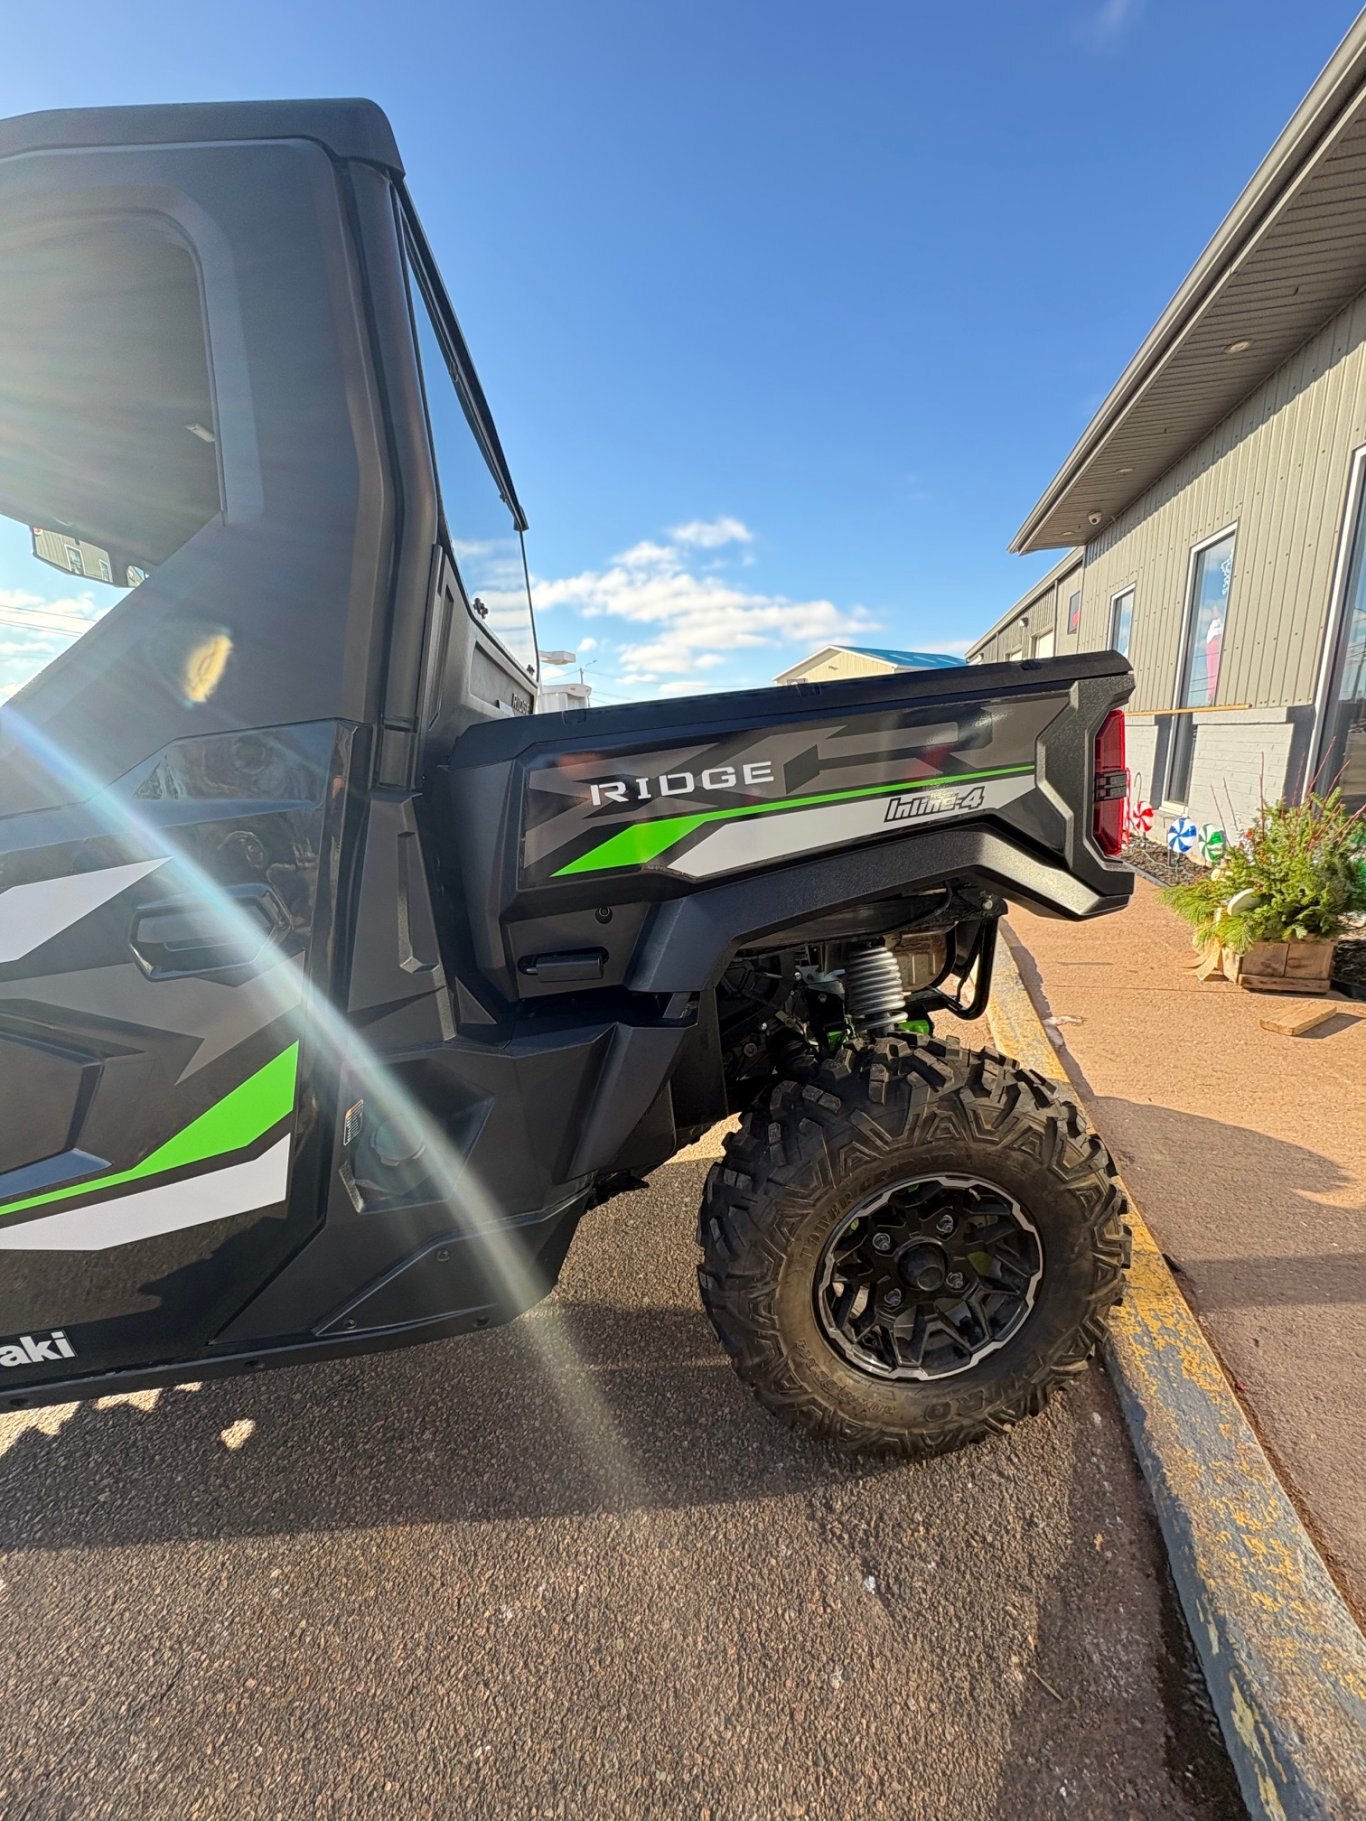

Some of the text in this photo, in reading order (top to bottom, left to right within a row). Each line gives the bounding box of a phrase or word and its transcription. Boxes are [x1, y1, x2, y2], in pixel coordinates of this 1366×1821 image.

[590, 761, 775, 806] RIDGE
[884, 786, 985, 822] Inline-4
[0, 1330, 76, 1367] aki
